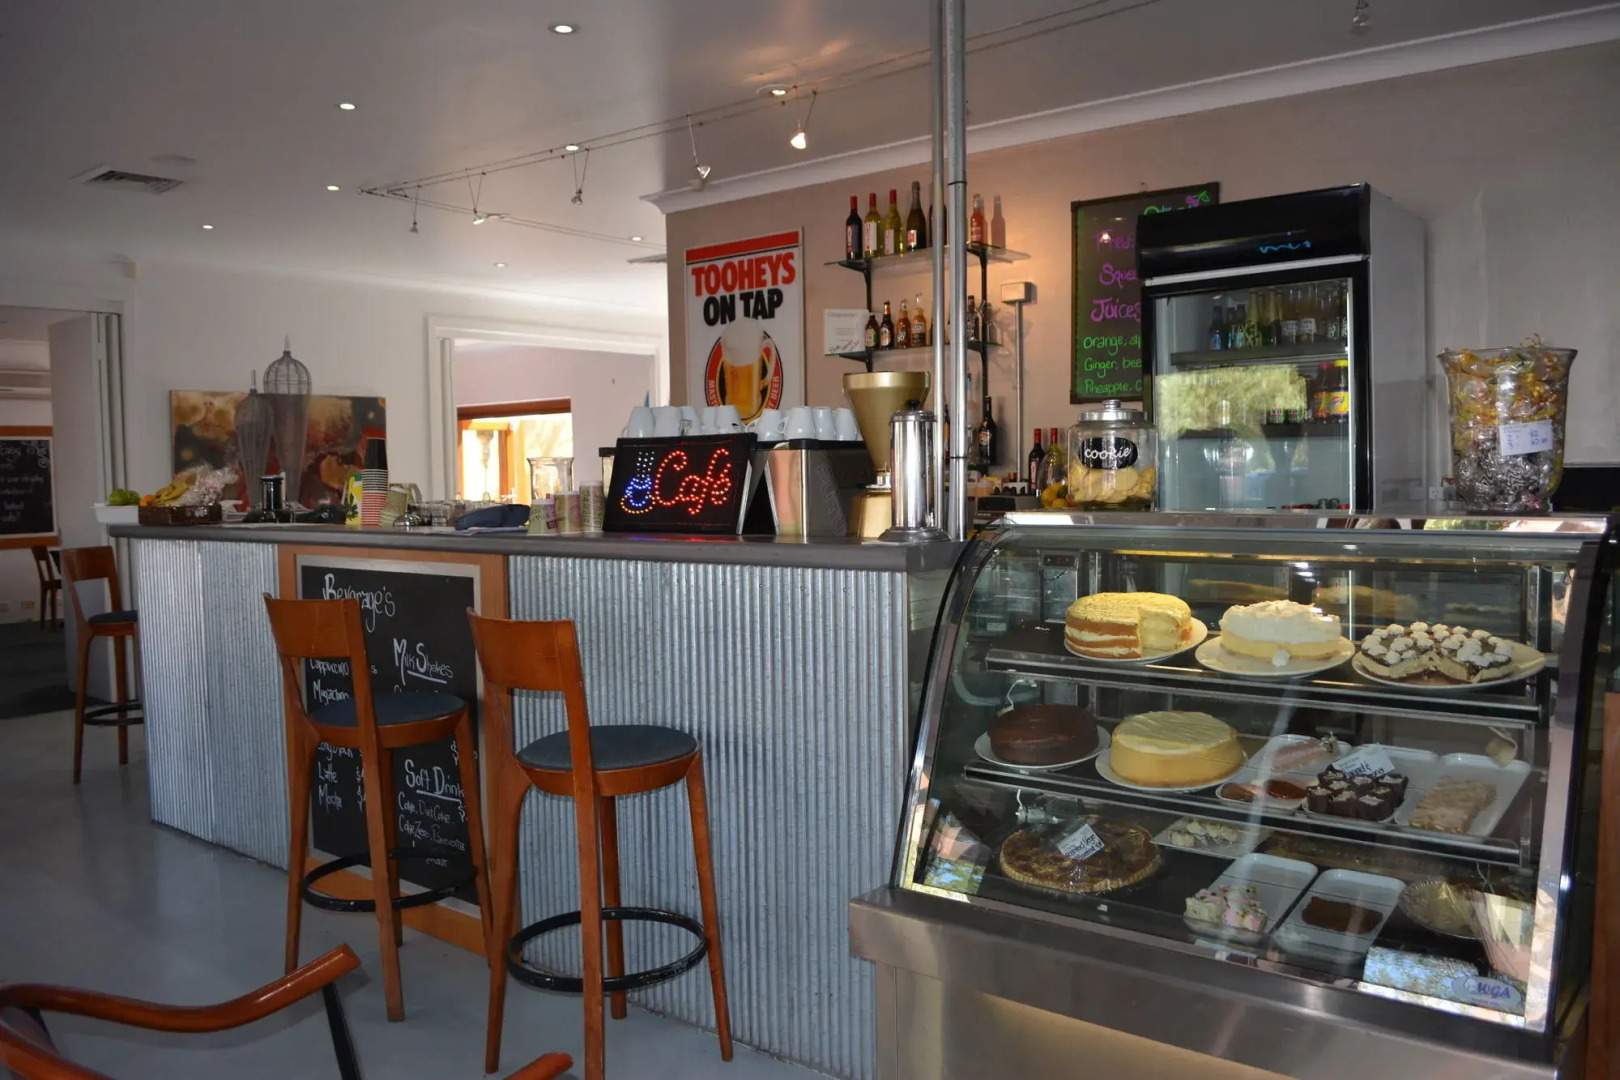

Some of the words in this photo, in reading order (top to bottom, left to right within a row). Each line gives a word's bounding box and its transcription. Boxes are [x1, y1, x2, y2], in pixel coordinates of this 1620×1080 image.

[691, 252, 796, 297] TOOHEYS
[703, 294, 736, 327] ON
[739, 288, 784, 320] TAP
[1090, 297, 1142, 323] Juices
[1084, 444, 1132, 460] cookie
[404, 758, 431, 791] Soft
